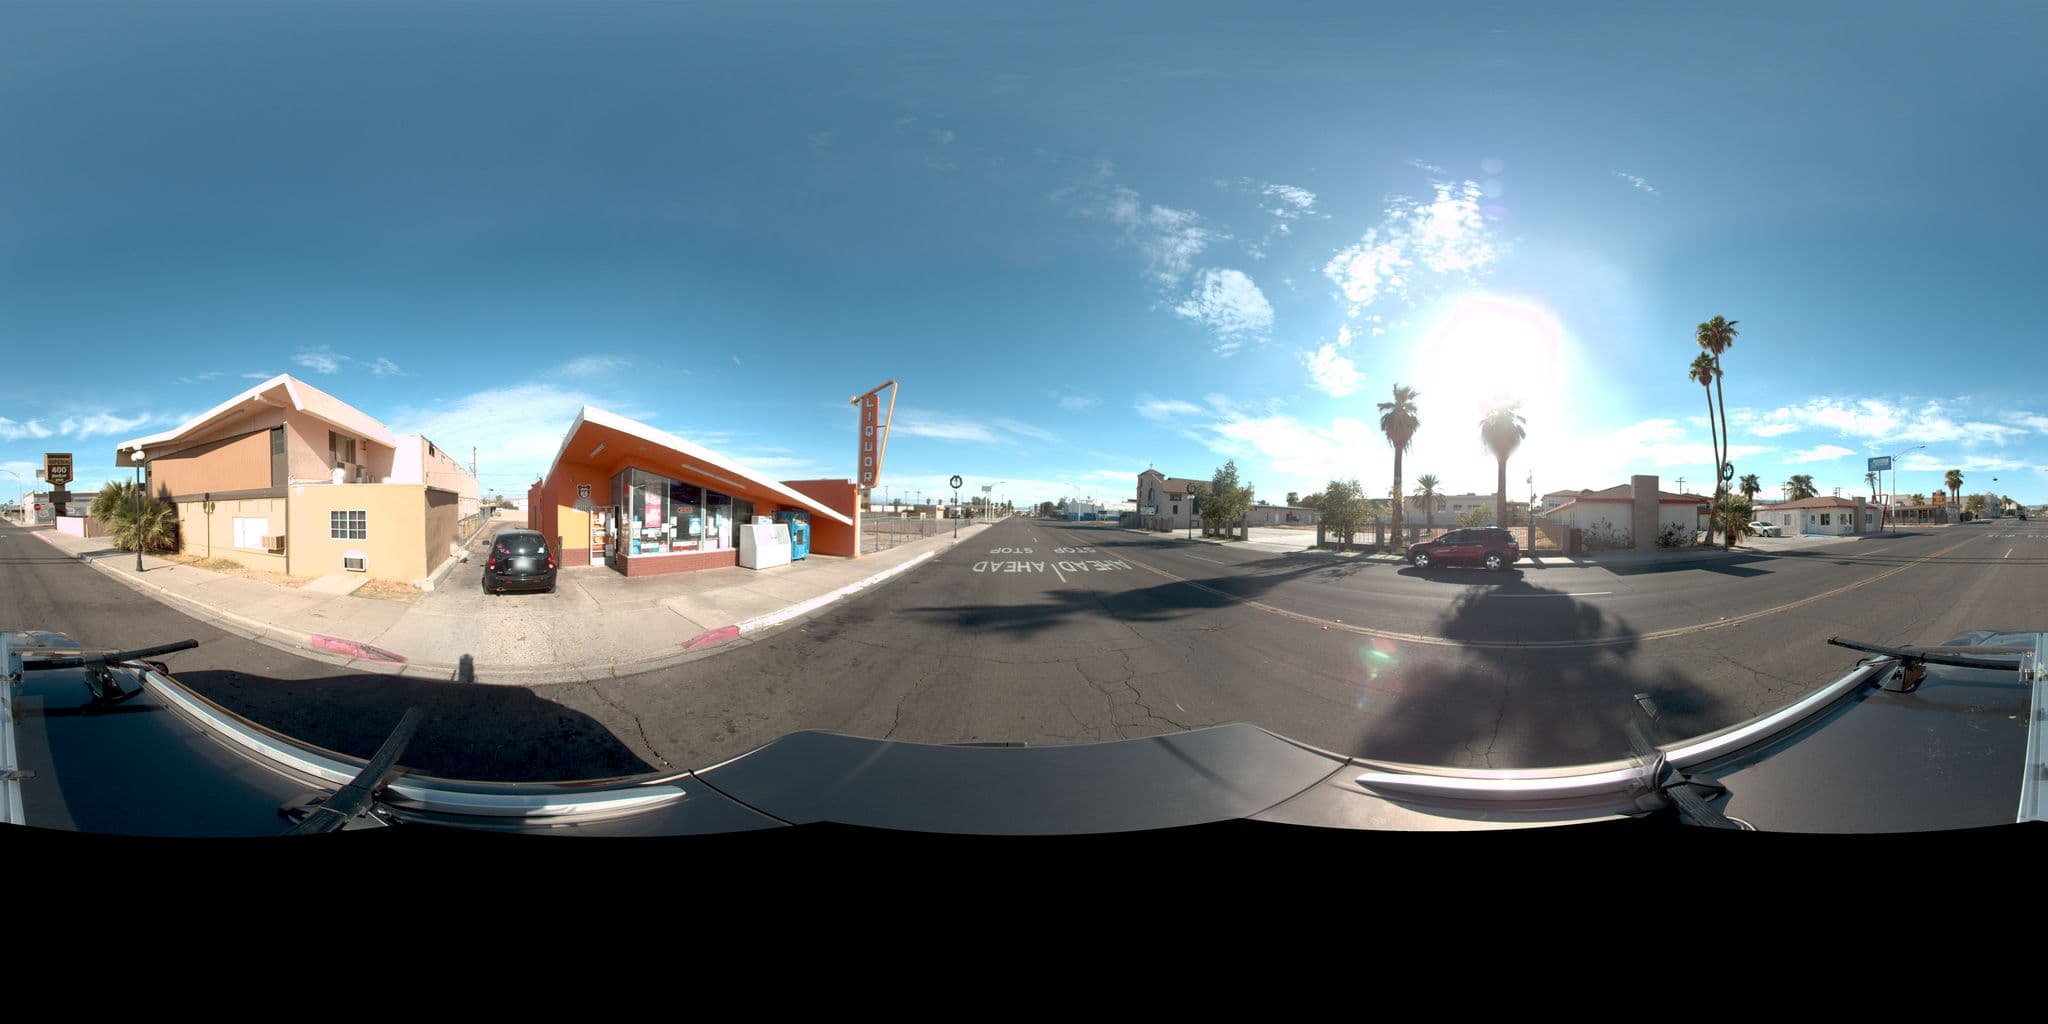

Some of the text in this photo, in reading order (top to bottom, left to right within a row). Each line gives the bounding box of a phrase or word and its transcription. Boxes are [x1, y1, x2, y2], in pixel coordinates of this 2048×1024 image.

[864, 399, 874, 482] LIQUOR
[990, 546, 1034, 554] STOP
[1054, 546, 1097, 554] STOP
[972, 561, 1045, 573] AHEAD
[1058, 560, 1133, 573] AHEAD
